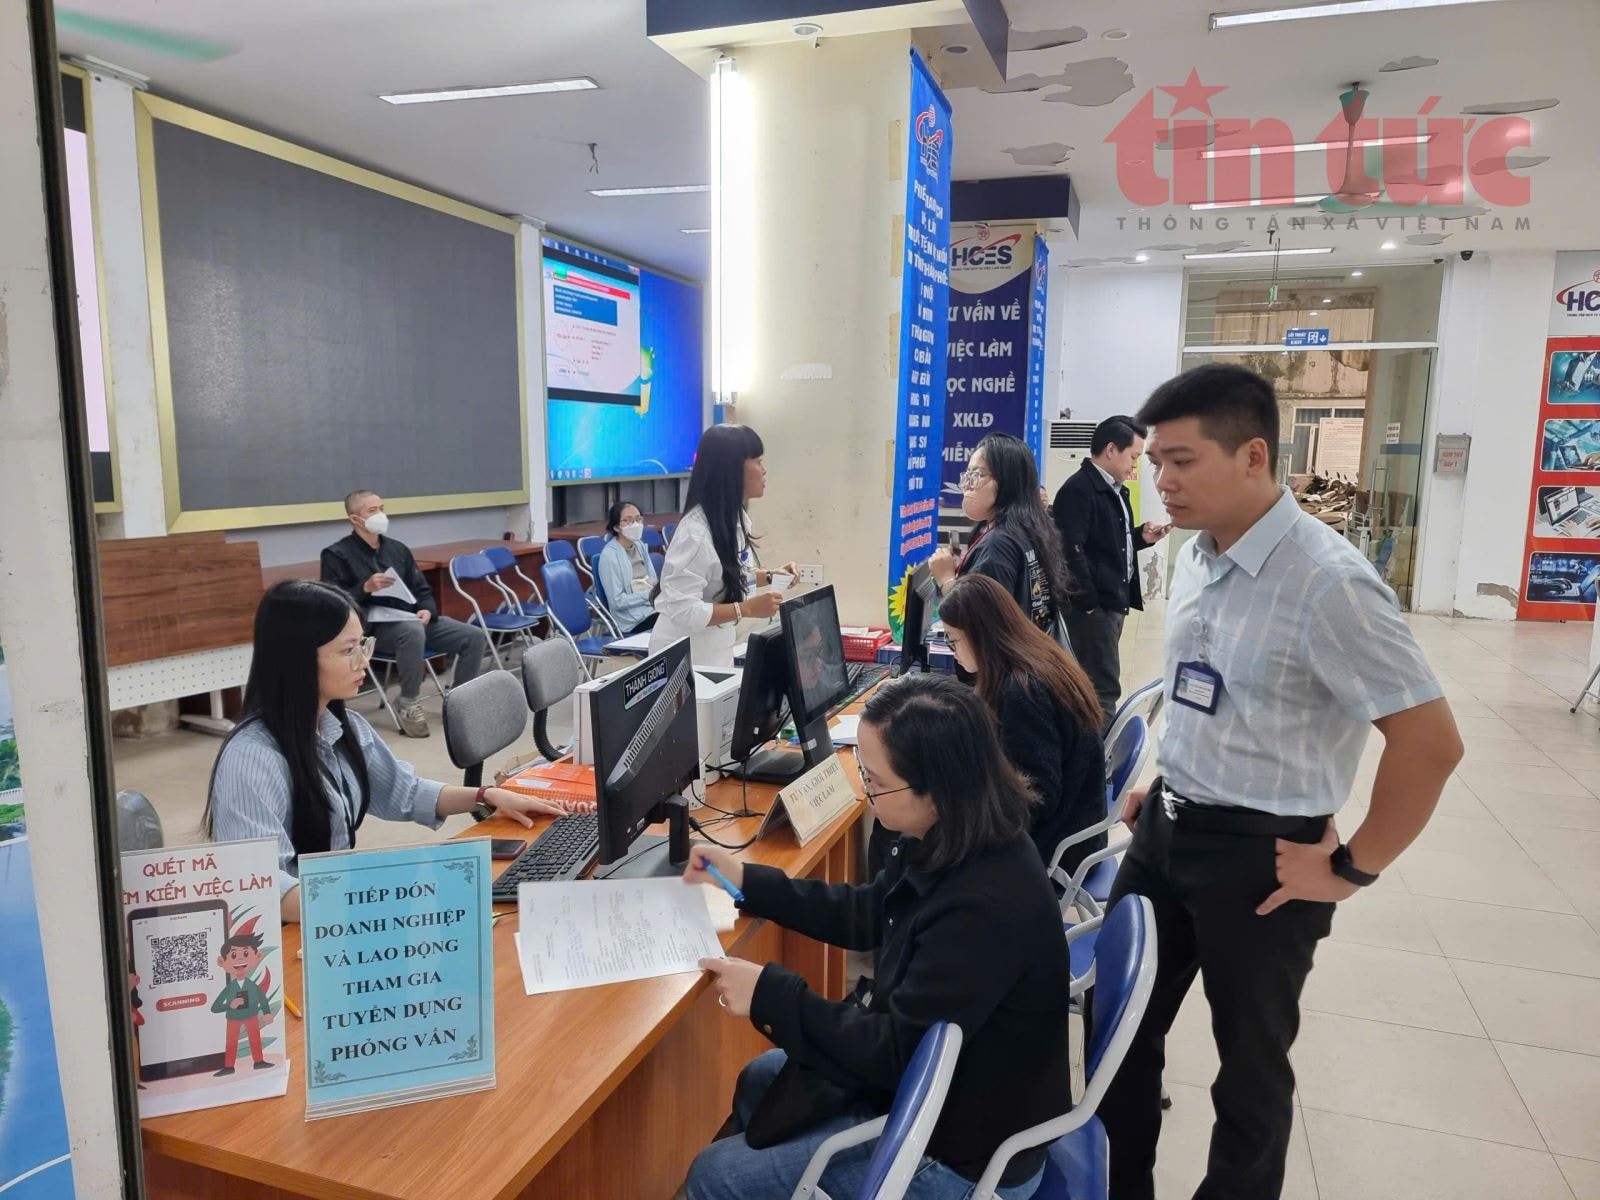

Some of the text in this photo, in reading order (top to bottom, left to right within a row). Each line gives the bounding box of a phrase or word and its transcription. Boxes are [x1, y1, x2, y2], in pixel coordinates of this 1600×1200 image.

[951, 245, 1013, 266] HCES
[947, 306, 959, 321] Ư
[962, 299, 995, 323] VẤN
[1001, 298, 1021, 320] VỀ
[1567, 291, 1600, 311] HC
[980, 338, 1013, 358] LÀM
[946, 377, 966, 397] ỌC
[971, 370, 1016, 394] NGHỀ
[953, 413, 994, 428] XKLĐ
[625, 672, 647, 697] THÁNH
[143, 853, 217, 877] QUÉT MÃ
[146, 880, 186, 902] KIẾM
[193, 877, 234, 897] VIỆC
[239, 873, 272, 891] LÀM
[344, 881, 436, 905] TIẾP ĐÓN
[314, 908, 466, 939] DOANH NGHIỆP
[324, 939, 459, 968] VÀ LAO ĐỘNG
[343, 971, 442, 995] THAM GIA
[163, 997, 201, 1007] SCANNING
[322, 997, 462, 1030] TUYỂN DỤNG
[331, 1027, 457, 1061] PHỎNG VẤN
